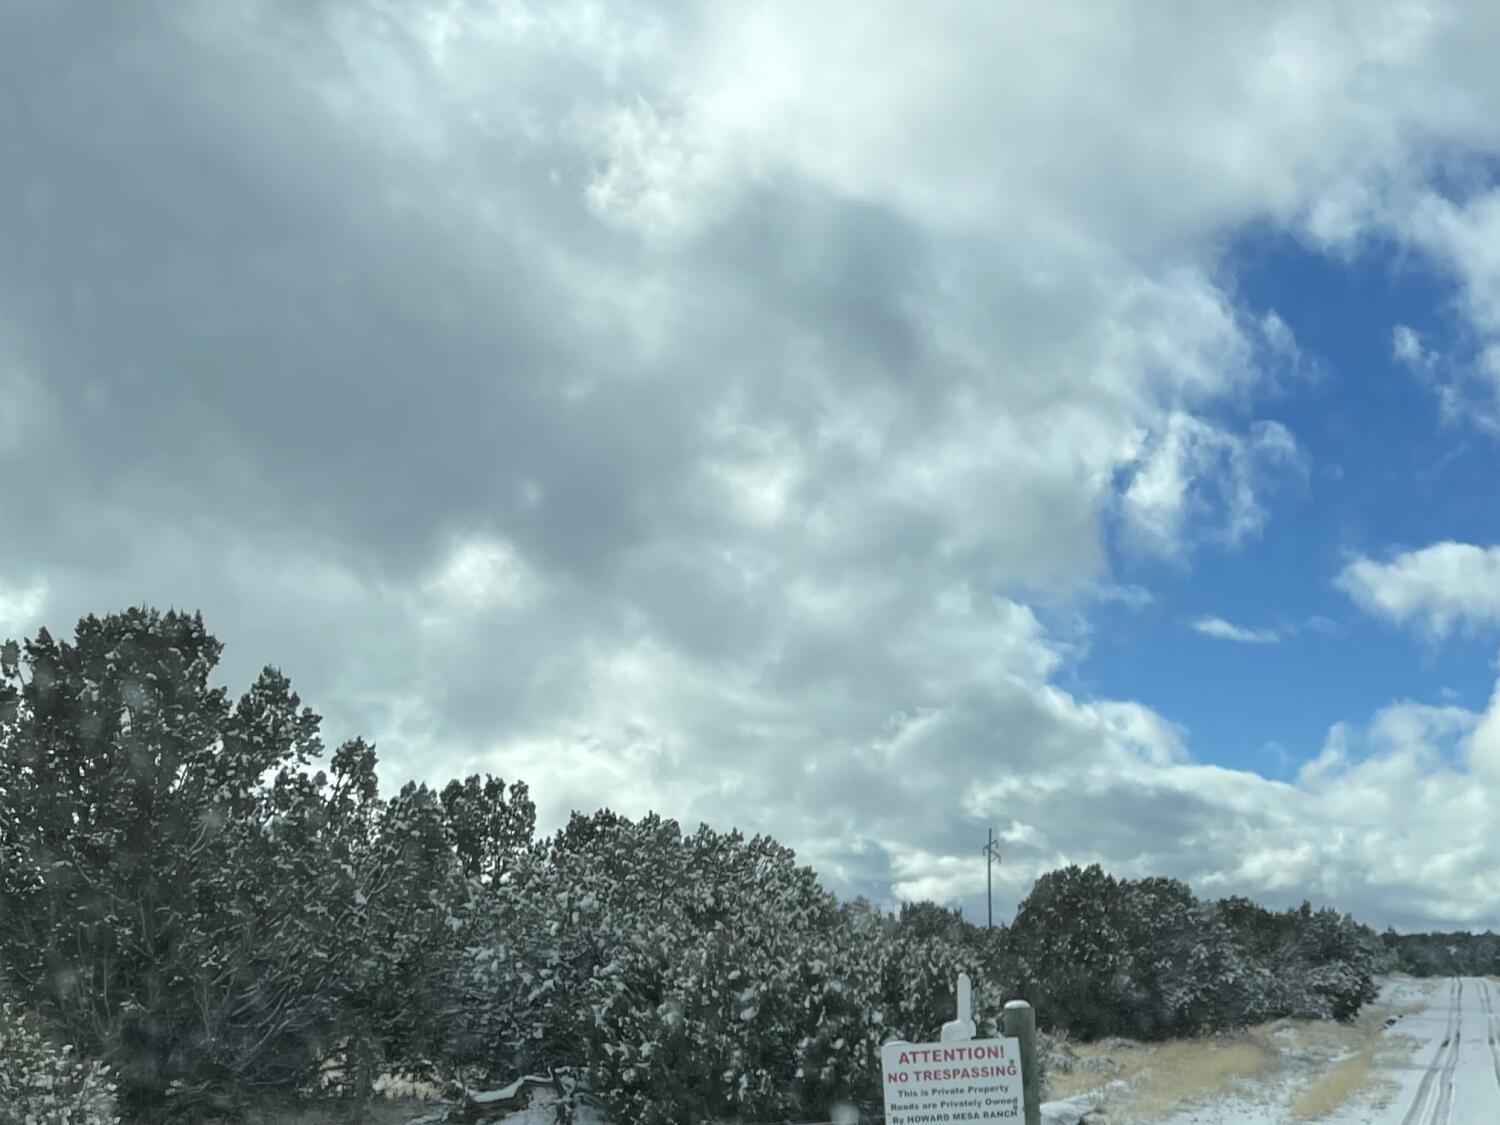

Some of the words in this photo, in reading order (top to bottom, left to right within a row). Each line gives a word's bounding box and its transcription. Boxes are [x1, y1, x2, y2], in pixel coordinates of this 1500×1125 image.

[899, 1046, 1004, 1064] ATTENTION!
[888, 1072, 908, 1083] NO
[914, 1065, 1016, 1081] TRESPASSING
[932, 1087, 965, 1096] Private
[968, 1085, 1008, 1094] Property
[941, 1099, 982, 1108] Privately
[986, 1097, 1017, 1105] Owned
[893, 1117, 904, 1125] By
[907, 1115, 949, 1123] HOWARD
[983, 1110, 1017, 1119] RANCH
